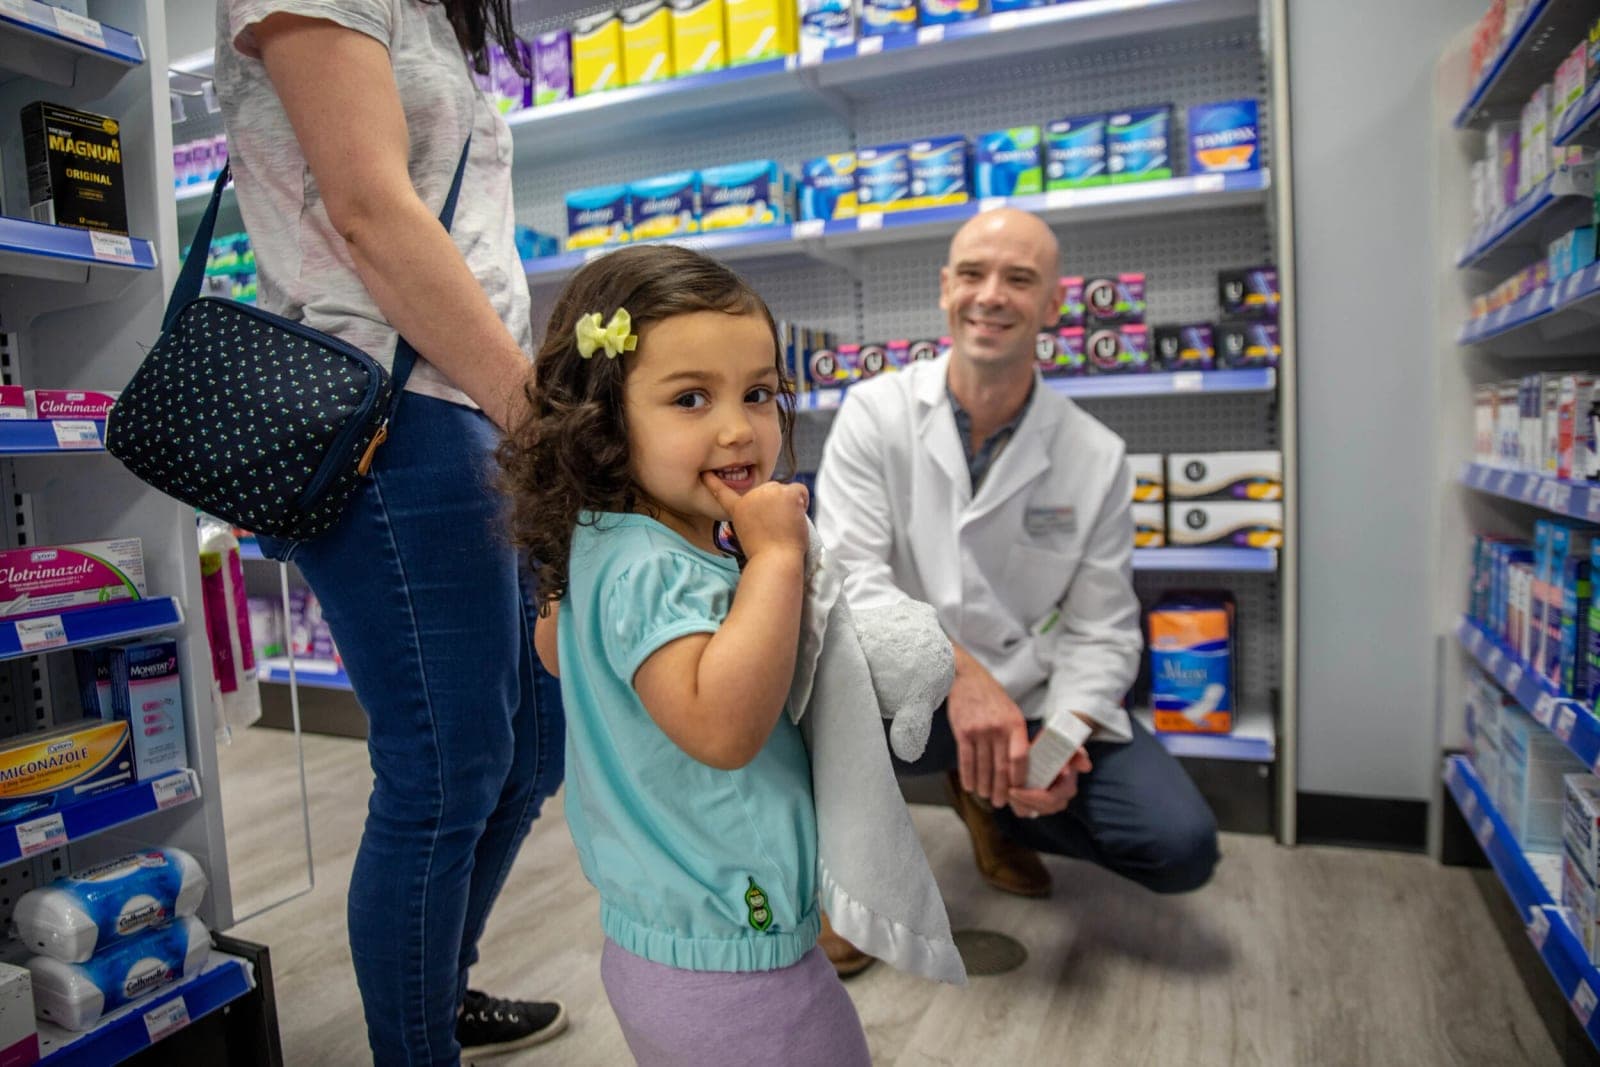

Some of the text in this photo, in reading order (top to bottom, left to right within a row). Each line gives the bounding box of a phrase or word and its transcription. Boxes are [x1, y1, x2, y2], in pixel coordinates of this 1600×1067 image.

[48, 134, 120, 164] MAGNUM
[65, 168, 112, 186] ORIGINAL
[0, 558, 95, 584] Clotrimazole
[0, 747, 88, 781] MICONAZOLE
